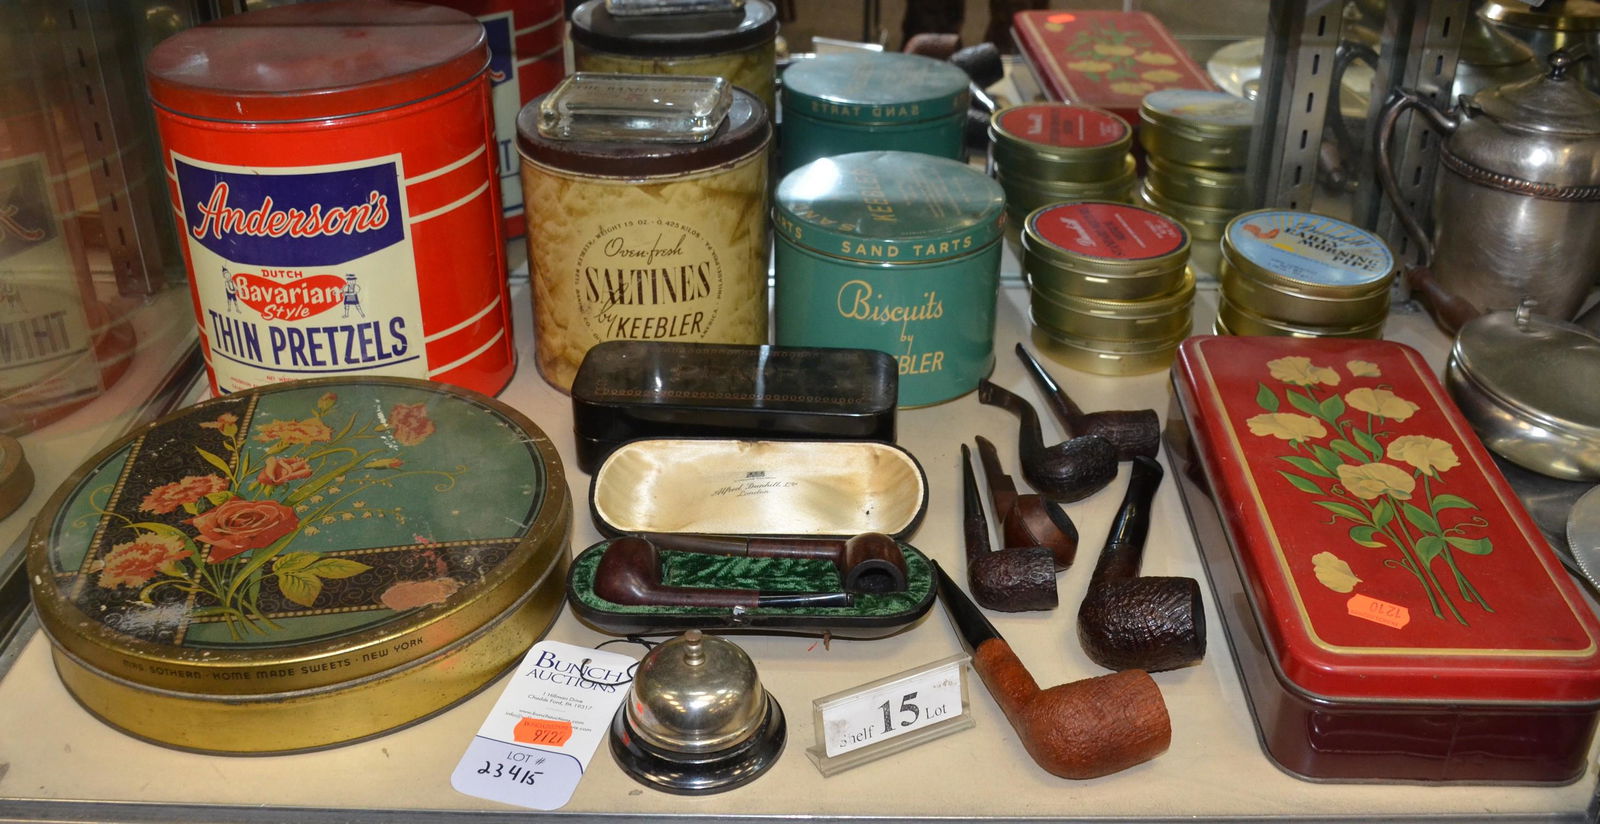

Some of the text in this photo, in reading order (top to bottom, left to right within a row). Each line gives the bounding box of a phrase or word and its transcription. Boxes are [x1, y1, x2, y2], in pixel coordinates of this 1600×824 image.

[193, 181, 390, 240] Anderson's
[841, 235, 974, 258] SAND TARTS
[261, 269, 303, 279] DUTCH
[585, 261, 711, 306] SALTINES
[236, 276, 344, 305] Bavarian
[837, 279, 944, 323] Biscuits
[260, 303, 311, 321] Style
[616, 311, 704, 339] KEEBLER
[208, 309, 408, 368] THIN PRETZELS
[213, 669, 250, 681] HOME
[256, 668, 295, 679] MADE
[301, 658, 351, 675] SWEETS
[362, 649, 389, 663] NEW
[393, 636, 424, 653] YORK
[535, 650, 623, 682] BUNCH
[525, 668, 617, 694] AUCTIONS
[878, 691, 920, 735] 15
[925, 703, 948, 720] Lot
[506, 751, 546, 765] LOT #
[477, 760, 544, 786] 23415
